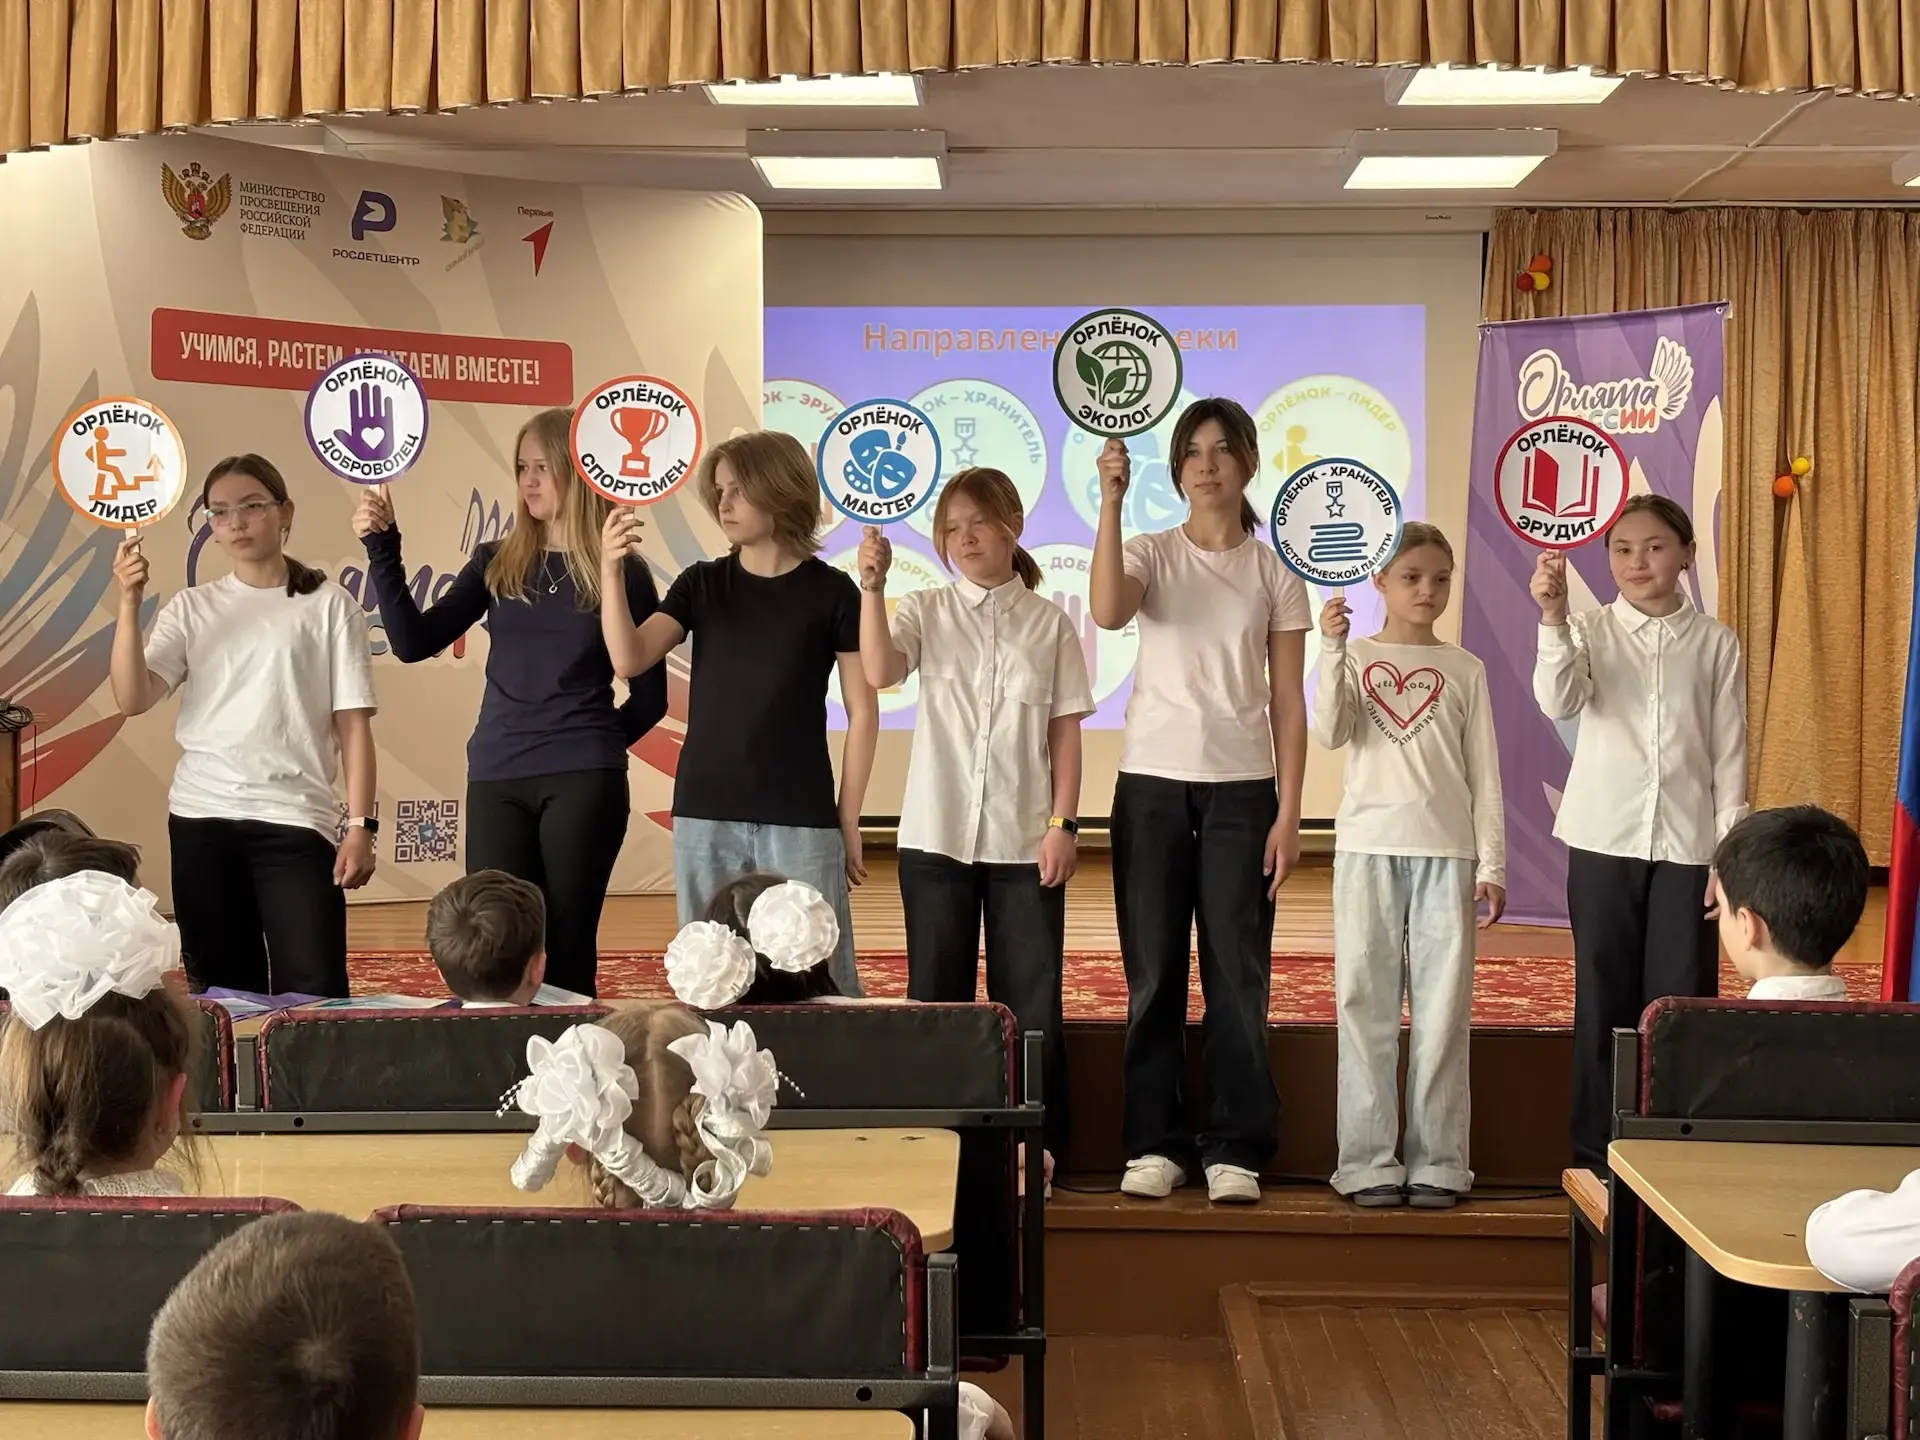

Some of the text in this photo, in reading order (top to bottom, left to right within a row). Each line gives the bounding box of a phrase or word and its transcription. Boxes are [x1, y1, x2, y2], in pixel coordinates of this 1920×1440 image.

[239, 181, 326, 203] МИНИСТЕРСТВО
[239, 195, 321, 216] ПРОСВЕЩЕНИЯ
[240, 208, 312, 228] РОССИЙСКОЙ
[240, 223, 306, 241] ФЕДЕРАЦИИ
[332, 248, 420, 267] РОСДЕТЦЕНТР
[864, 323, 1060, 357] Направлен
[1072, 316, 1162, 348] ОРЛЁНОК
[180, 330, 263, 370] УЧИМСЯ,
[455, 355, 541, 386] ВМЕСТЕ!
[325, 361, 410, 394] ОРЛЁНОК
[1521, 353, 1660, 417] Орлята
[595, 383, 687, 418] ОРЛЁНОК
[1078, 403, 1153, 429] ЭКОЛОГ
[72, 404, 165, 436] ОРЛЁНОК
[838, 406, 924, 435] ОРЛЁНОК
[963, 390, 1043, 465] ХРАНИТЕЛЬ
[318, 432, 419, 476] ДОБРОВОЛЕЦ
[1517, 424, 1610, 459] ОРЛЁНОК
[580, 453, 688, 496] СПОРТСМЕН
[841, 492, 916, 516] МАСТЕР
[1330, 466, 1394, 516] ХРАНИТЕЛЬ
[89, 499, 158, 522] ЛИДЕР
[1516, 515, 1597, 541] ЭРУДИТ
[1281, 532, 1393, 580] ИСТОРИЧЕСКОЙ ПАМЯТИ
[1398, 723, 1425, 746] LOVELY
